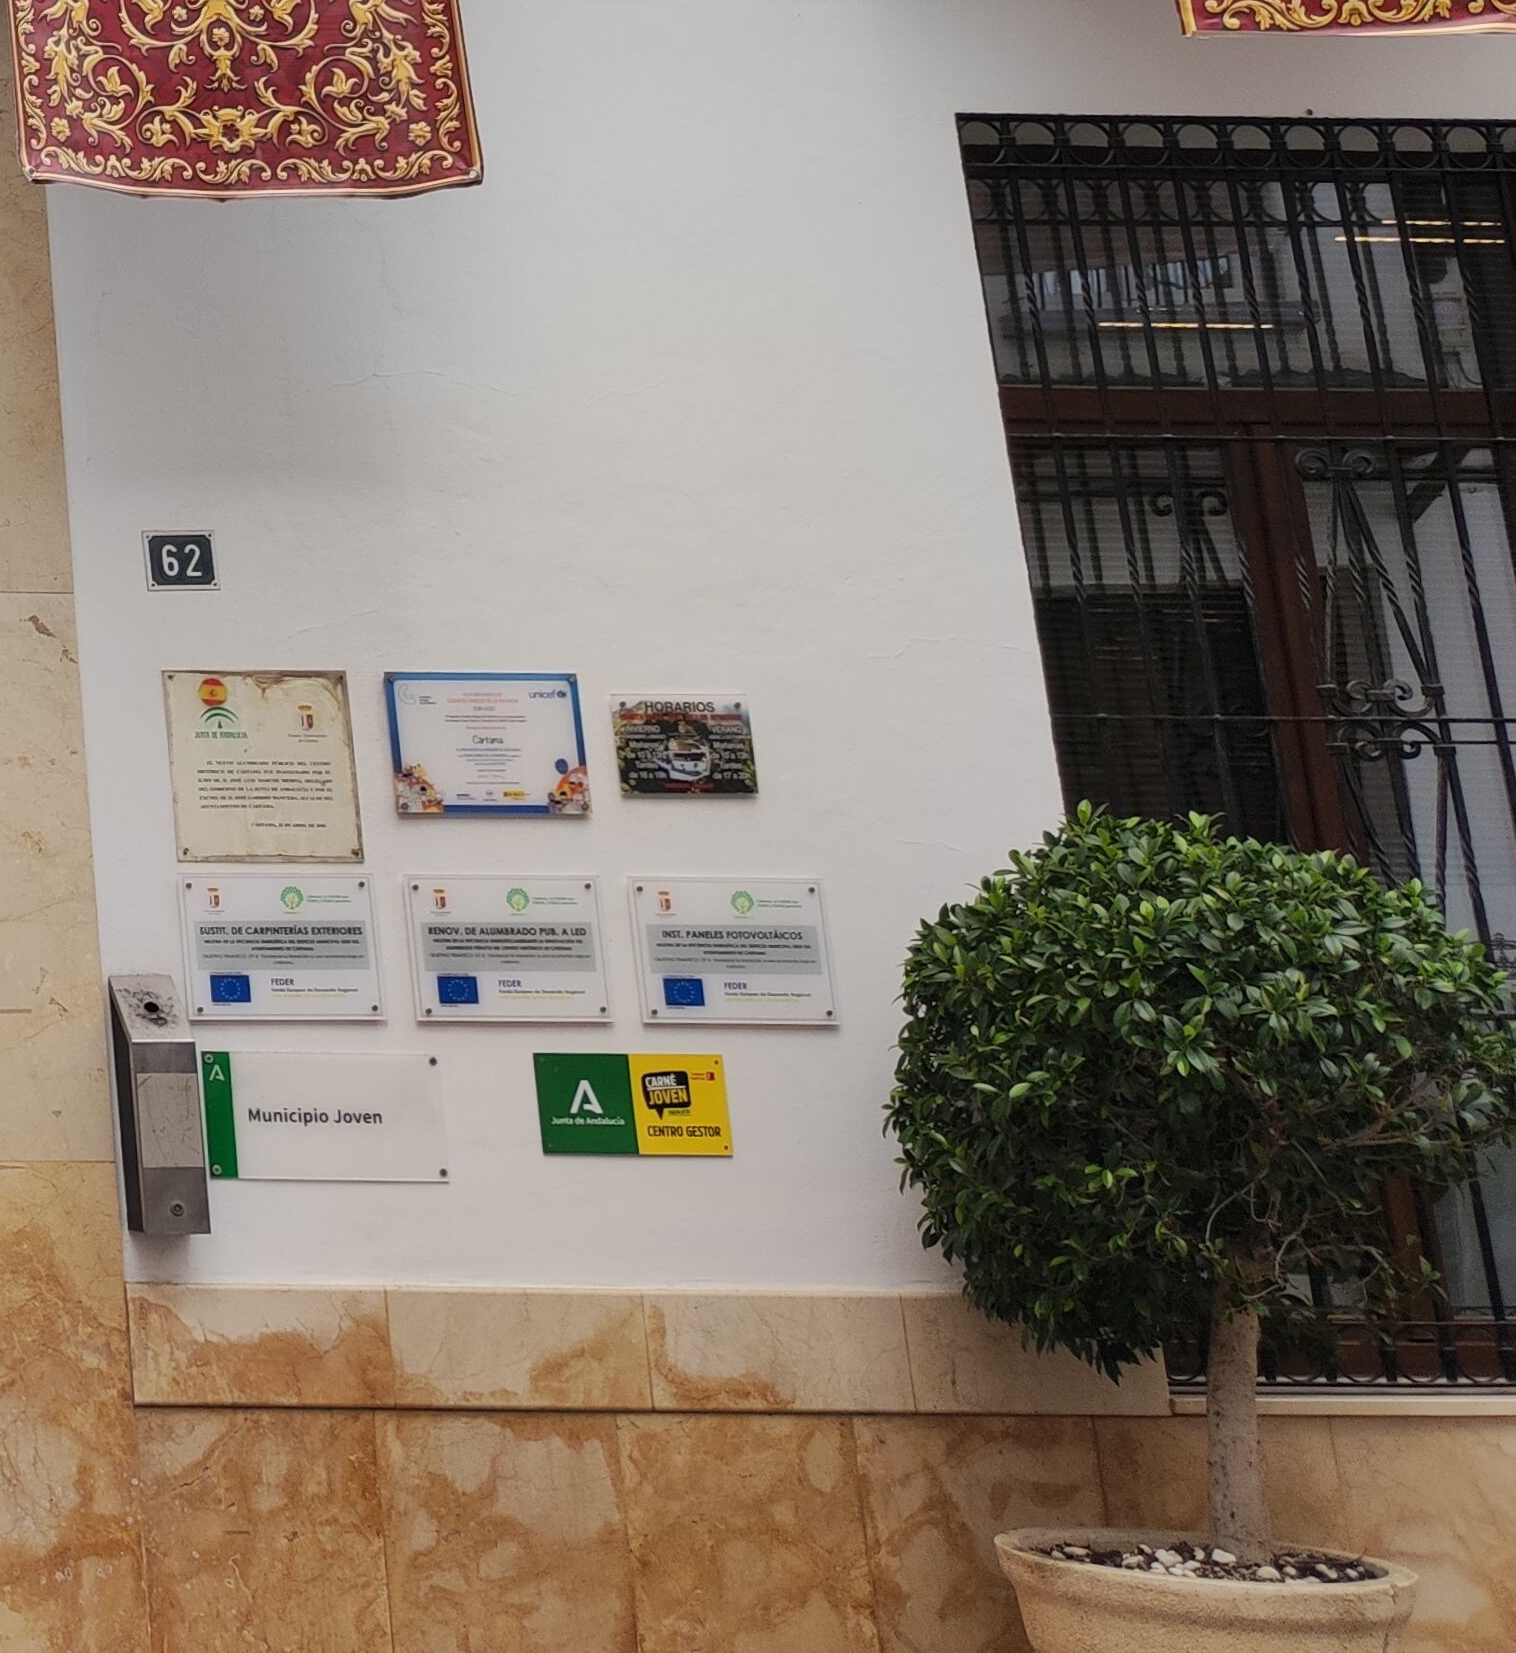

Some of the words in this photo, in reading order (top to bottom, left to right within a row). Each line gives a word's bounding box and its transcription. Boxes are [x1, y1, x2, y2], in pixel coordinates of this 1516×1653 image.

[162, 544, 202, 576] 62
[528, 690, 555, 699] unicef
[645, 701, 715, 712] HORARIOS
[200, 926, 228, 936] SUSTIT.
[232, 926, 243, 935] DE
[245, 924, 308, 936] CARPINTERÍAS
[311, 926, 363, 936] EXTERIORES
[428, 926, 463, 936] RENOV.
[465, 927, 477, 936] DE
[479, 927, 537, 936] ALUMBRADO
[539, 927, 559, 936] PUB.
[561, 928, 568, 936] A
[570, 928, 587, 936] LED
[662, 930, 684, 939] INST.
[686, 930, 724, 940] PANELES
[726, 929, 803, 941] FOTOVOLTÁICOS
[271, 978, 294, 986] FEDER
[498, 980, 521, 988] FEDER
[724, 982, 747, 990] FEDER
[645, 1073, 677, 1088] CARNÉ
[648, 1089, 688, 1105] JOVEN
[248, 1108, 329, 1126] Municipio
[333, 1110, 383, 1124] Joven
[551, 1117, 574, 1126] Junta
[575, 1117, 585, 1125] de
[586, 1116, 625, 1126] Andalucía
[647, 1125, 683, 1137] CENTRO
[686, 1126, 722, 1137] GESTOR
